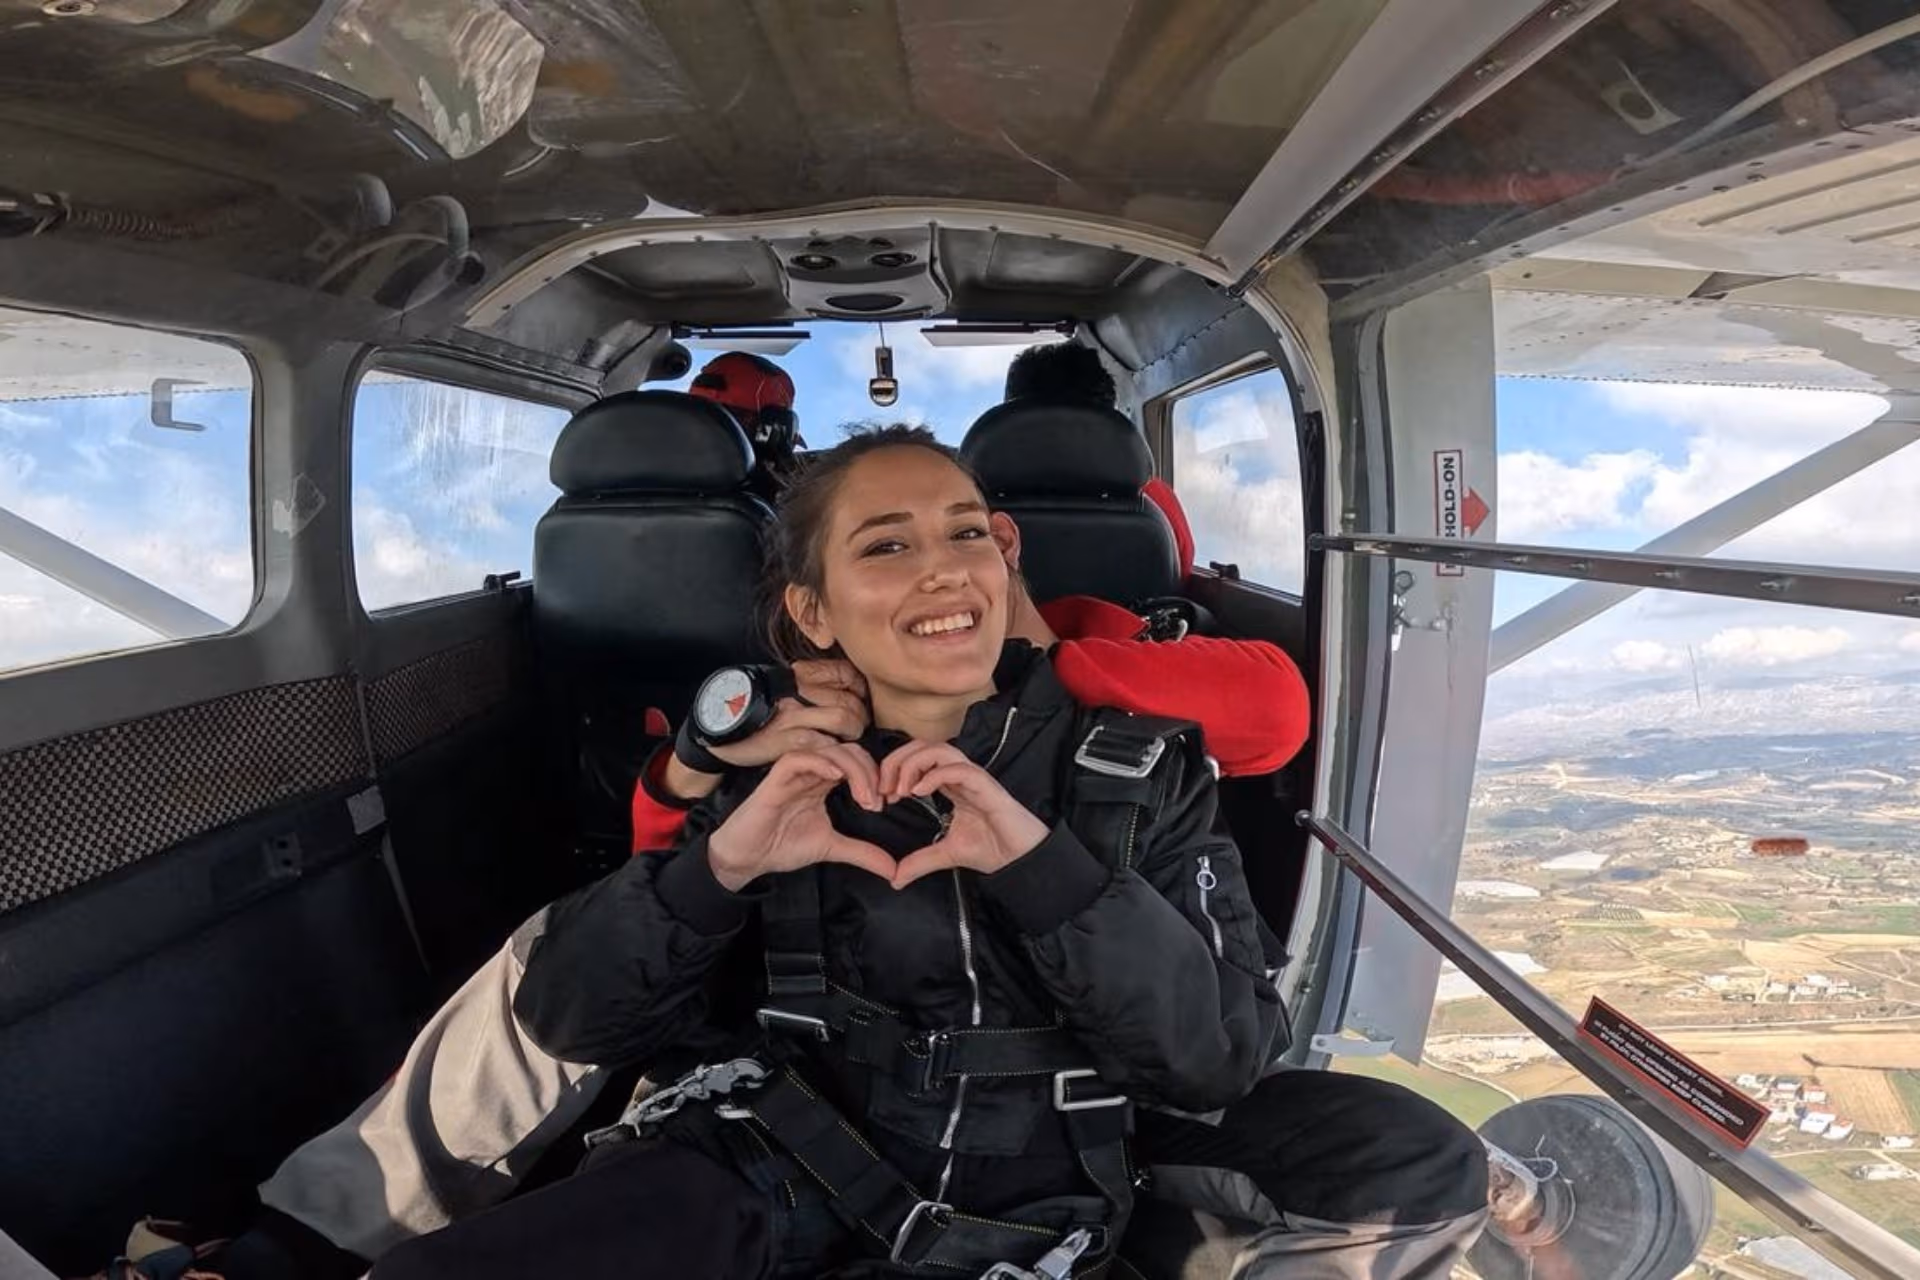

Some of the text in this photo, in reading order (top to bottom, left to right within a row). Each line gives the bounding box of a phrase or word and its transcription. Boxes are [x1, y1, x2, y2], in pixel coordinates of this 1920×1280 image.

[1443, 457, 1456, 537] HOLD-ON
[1629, 1053, 1671, 1086] OTHERWISE
[1669, 1082, 1692, 1101] KEEP
[1663, 1053, 1698, 1079] AGAINST
[1689, 1086, 1744, 1127] COMMANDED
